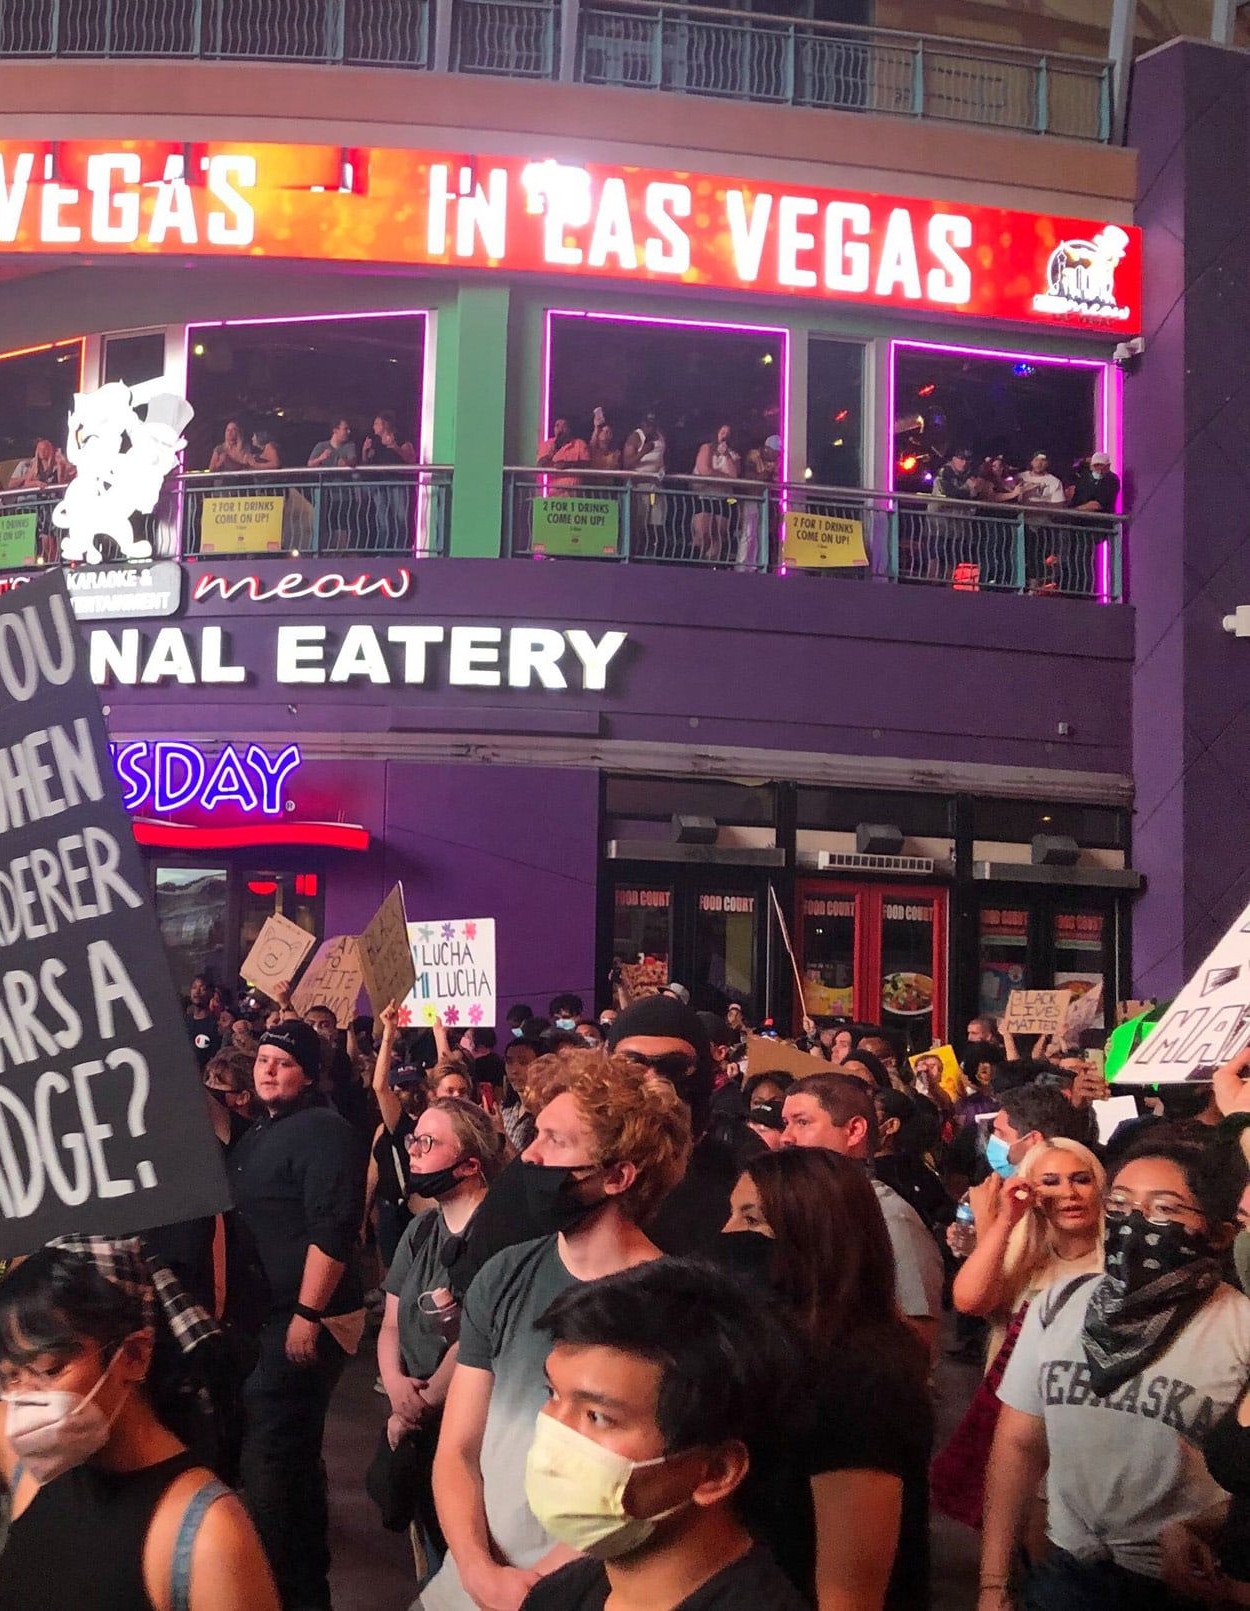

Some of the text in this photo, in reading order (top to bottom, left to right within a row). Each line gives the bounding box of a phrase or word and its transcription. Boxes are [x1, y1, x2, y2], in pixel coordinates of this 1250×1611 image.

[428, 165, 506, 258] IN
[726, 191, 973, 304] VEGAS
[212, 503, 217, 512] 2
[219, 502, 234, 512] FOR
[244, 501, 274, 511] DRINKS
[543, 501, 548, 511] 2
[551, 502, 568, 512] FOR
[578, 503, 609, 514] DRINKS
[215, 513, 269, 524] COME ON UP!
[547, 514, 605, 526] COME ON UP!
[793, 517, 798, 527] 2
[800, 517, 815, 528] FOR
[825, 521, 853, 533] DRINKS
[797, 530, 849, 545] COME ON UP!
[67, 569, 137, 590] KARAOKE
[195, 569, 410, 600] meow
[277, 625, 628, 689] EATERY
[615, 890, 671, 908] FOOD COURT
[700, 895, 754, 913] FOOD COURT
[826, 901, 855, 918] COURT
[905, 904, 934, 921] COURT
[422, 942, 475, 967] LUCHA
[87, 940, 154, 1038] A
[436, 969, 493, 998] LUCHA
[1011, 991, 1056, 1006] BLACK
[1010, 1005, 1060, 1017] LIVES
